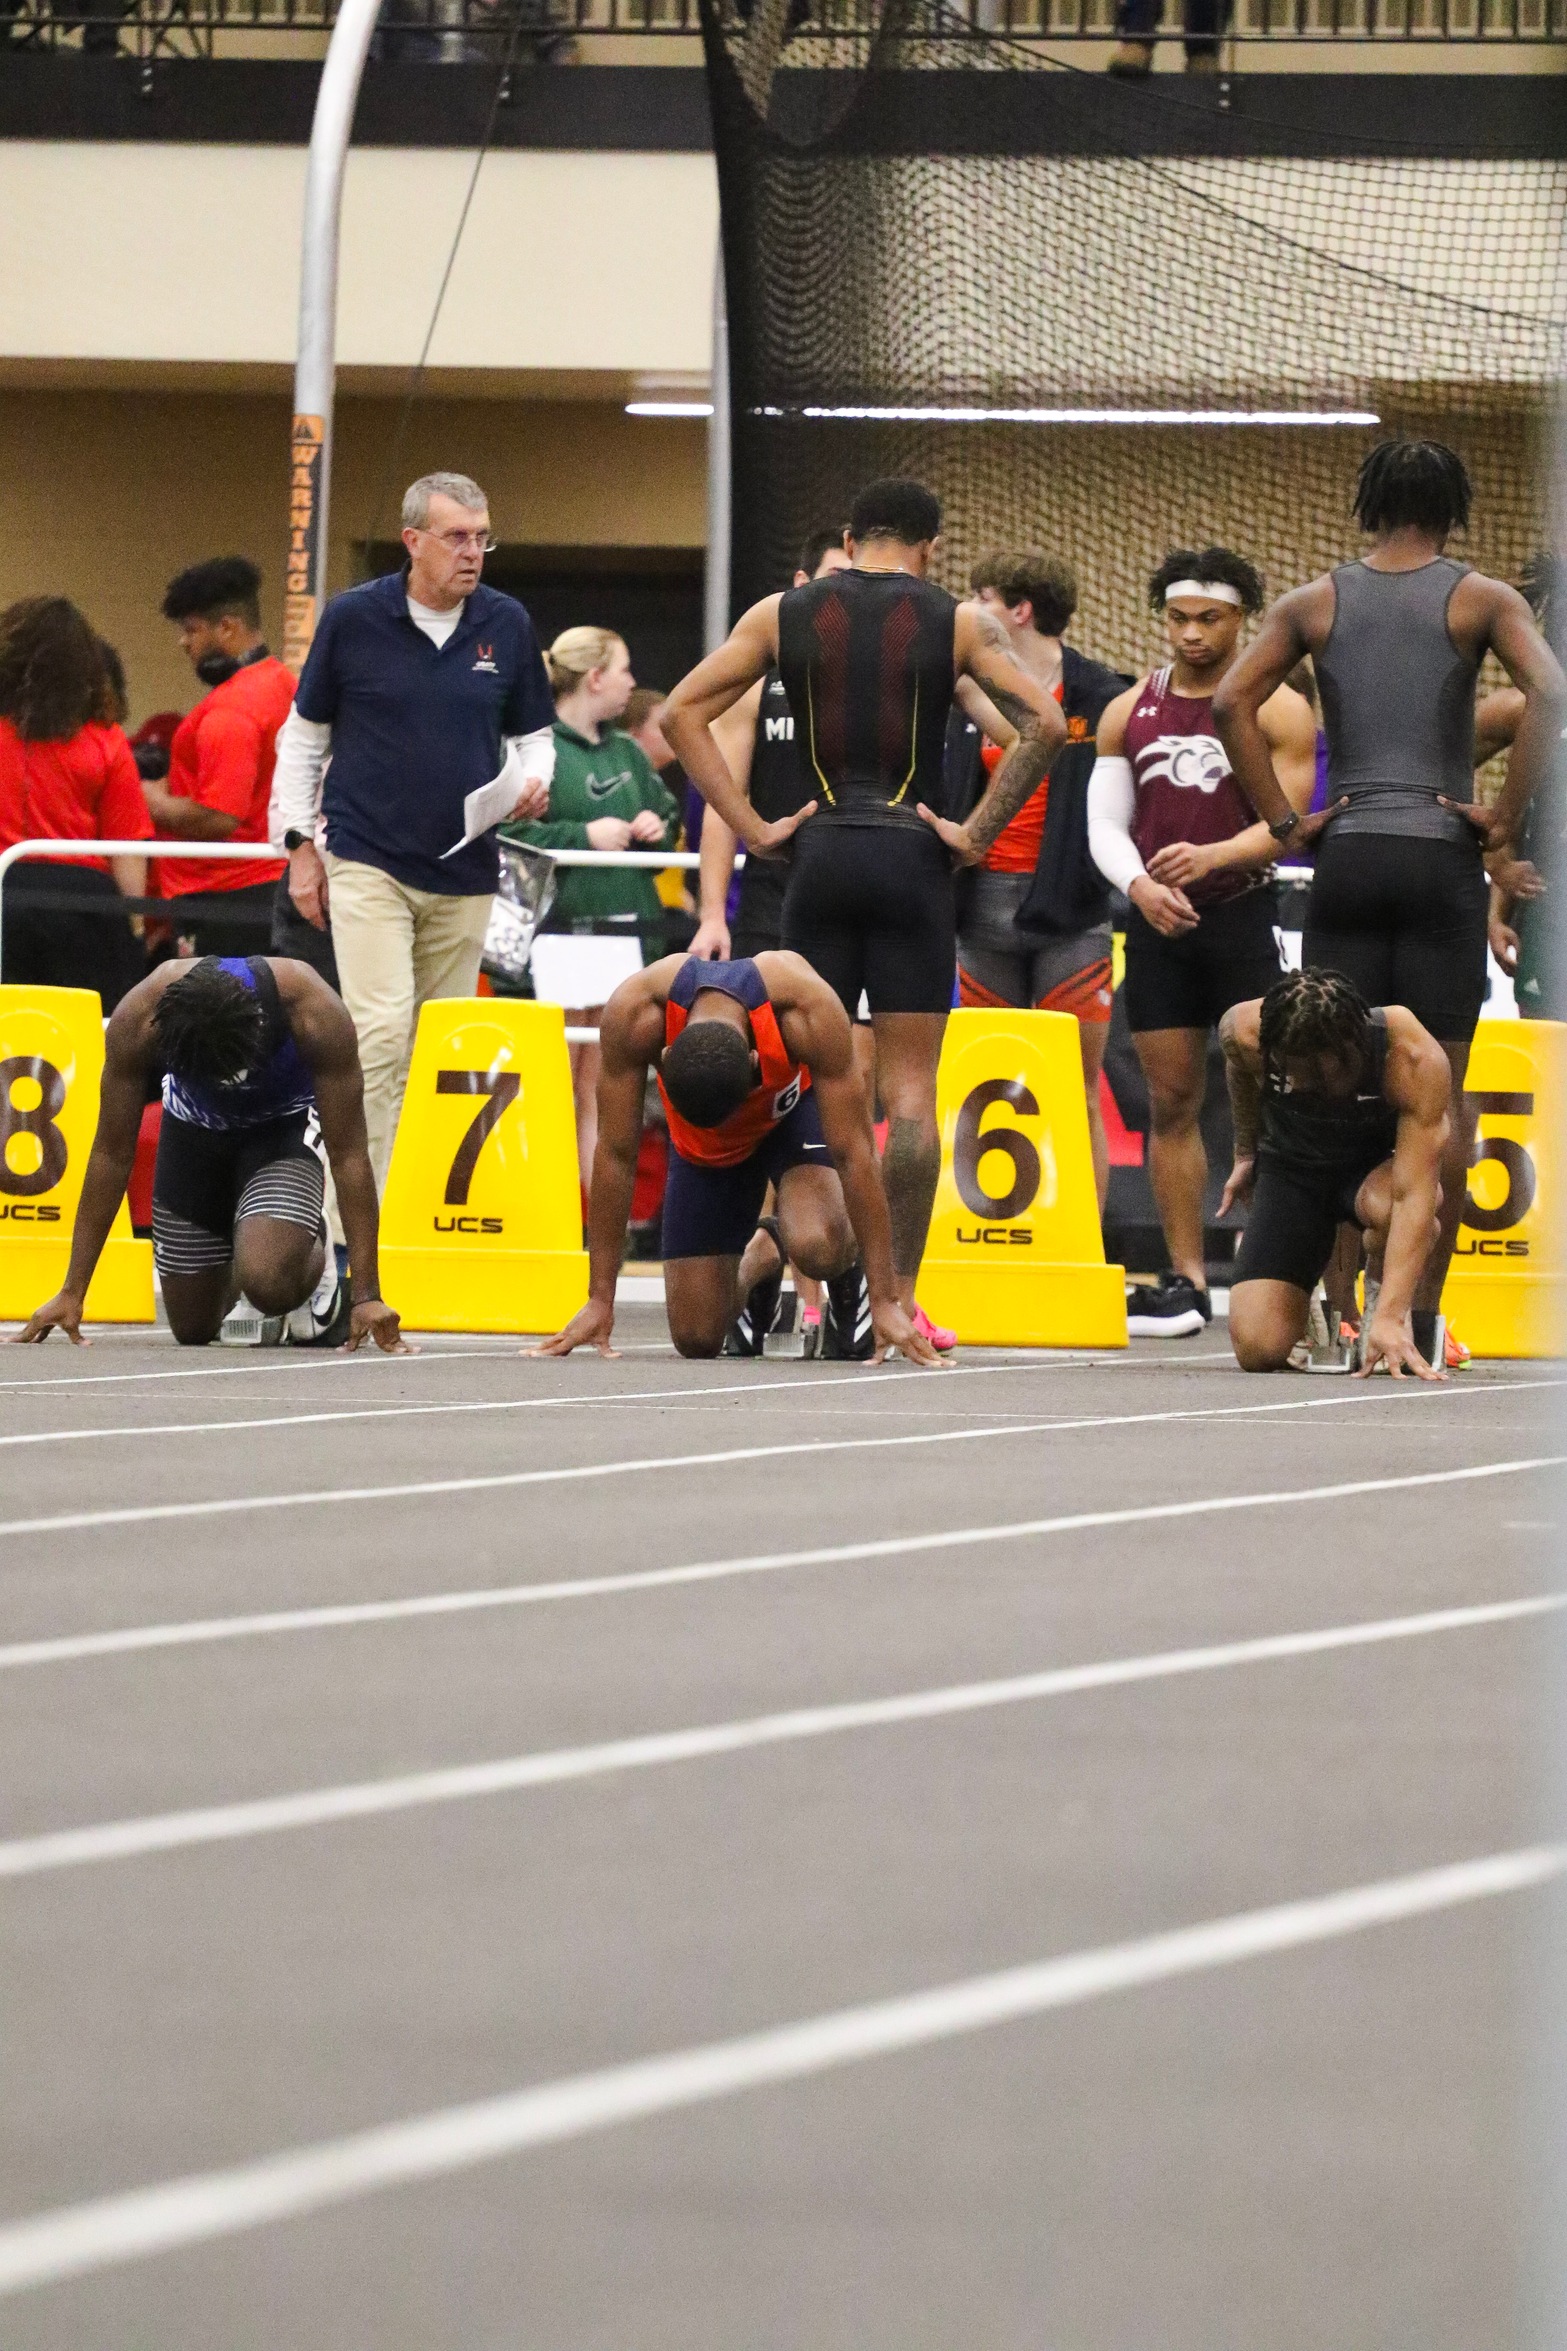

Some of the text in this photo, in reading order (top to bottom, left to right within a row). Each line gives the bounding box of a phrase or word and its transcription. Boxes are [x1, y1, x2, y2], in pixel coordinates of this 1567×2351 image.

[0, 1055, 68, 1197] 8
[436, 1070, 521, 1206] 7
[953, 1078, 1041, 1221] 6
[1460, 1091, 1536, 1232] 5
[434, 1216, 503, 1233] UCS
[956, 1227, 1033, 1244] UCS
